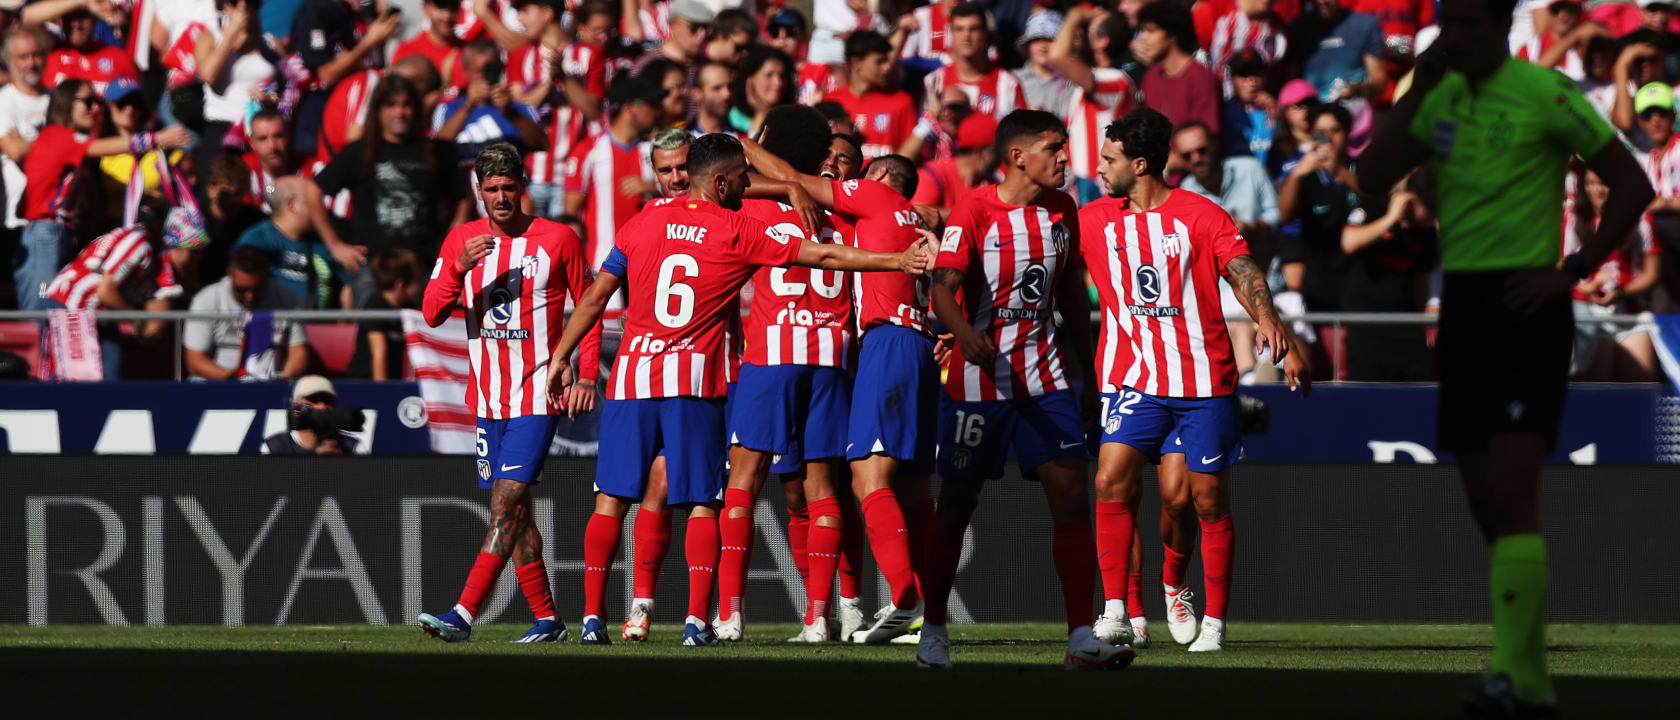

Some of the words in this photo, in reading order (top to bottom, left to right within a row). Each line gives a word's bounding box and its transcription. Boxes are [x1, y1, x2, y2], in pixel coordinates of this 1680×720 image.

[666, 223, 708, 244] KOKE
[770, 222, 845, 299] 20
[654, 253, 699, 328] 6
[777, 301, 813, 326] ria
[1128, 305, 1159, 316] RIYADH
[1162, 307, 1179, 316] AIR
[480, 328, 510, 339] RIYADH
[511, 330, 529, 339] AIR
[629, 332, 666, 354] ria
[954, 409, 985, 447] 16
[476, 427, 489, 457] 5
[25, 496, 643, 628] RIYADH
